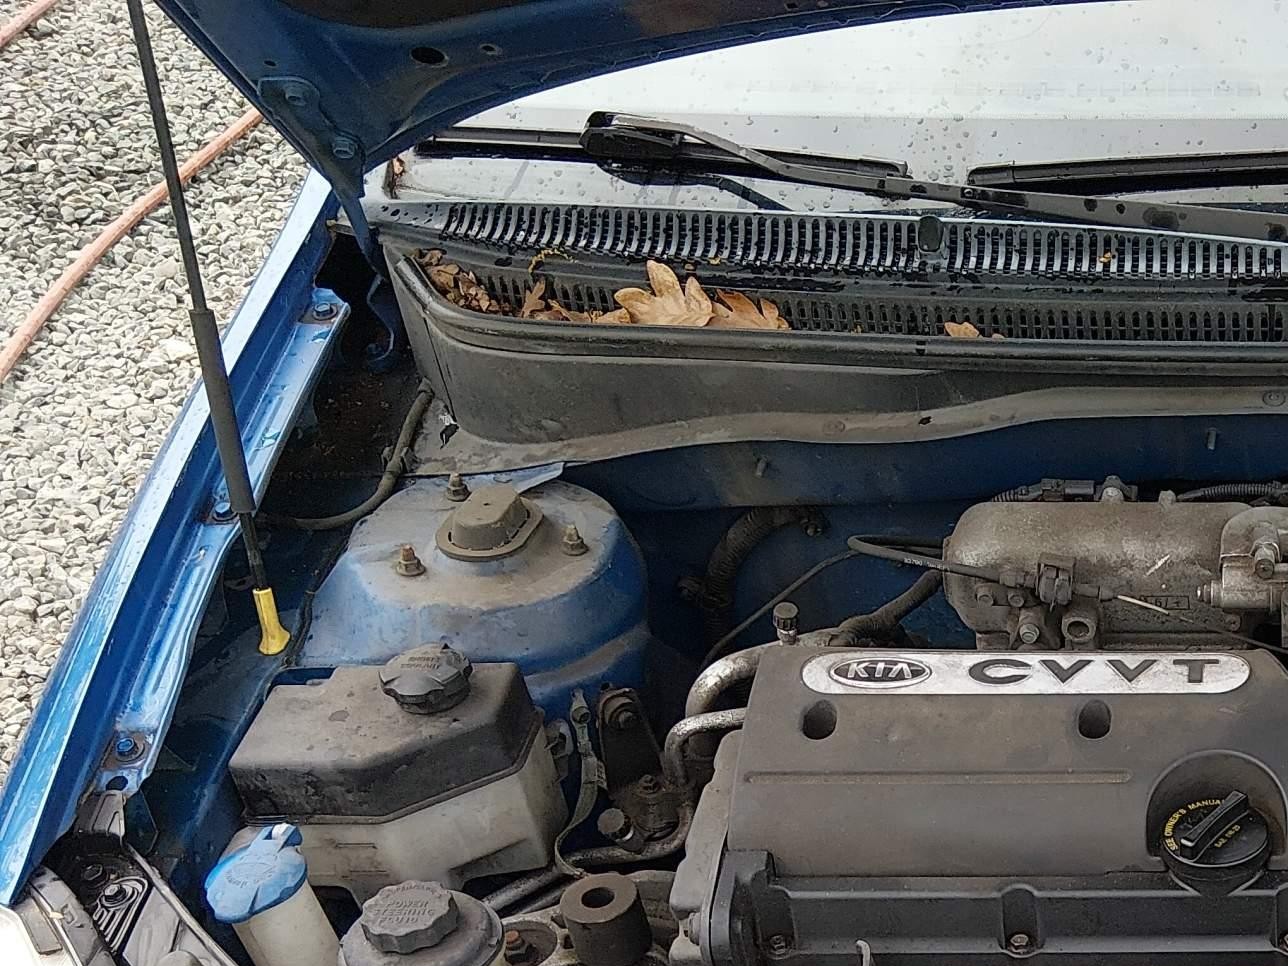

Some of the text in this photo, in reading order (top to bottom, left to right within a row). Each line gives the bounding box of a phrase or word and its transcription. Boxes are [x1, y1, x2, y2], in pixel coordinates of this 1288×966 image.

[847, 658, 1220, 684] KIA CVVT
[1164, 808, 1187, 836] OWNER'S
[373, 908, 435, 916] STEERING
[386, 900, 429, 908] POWER
